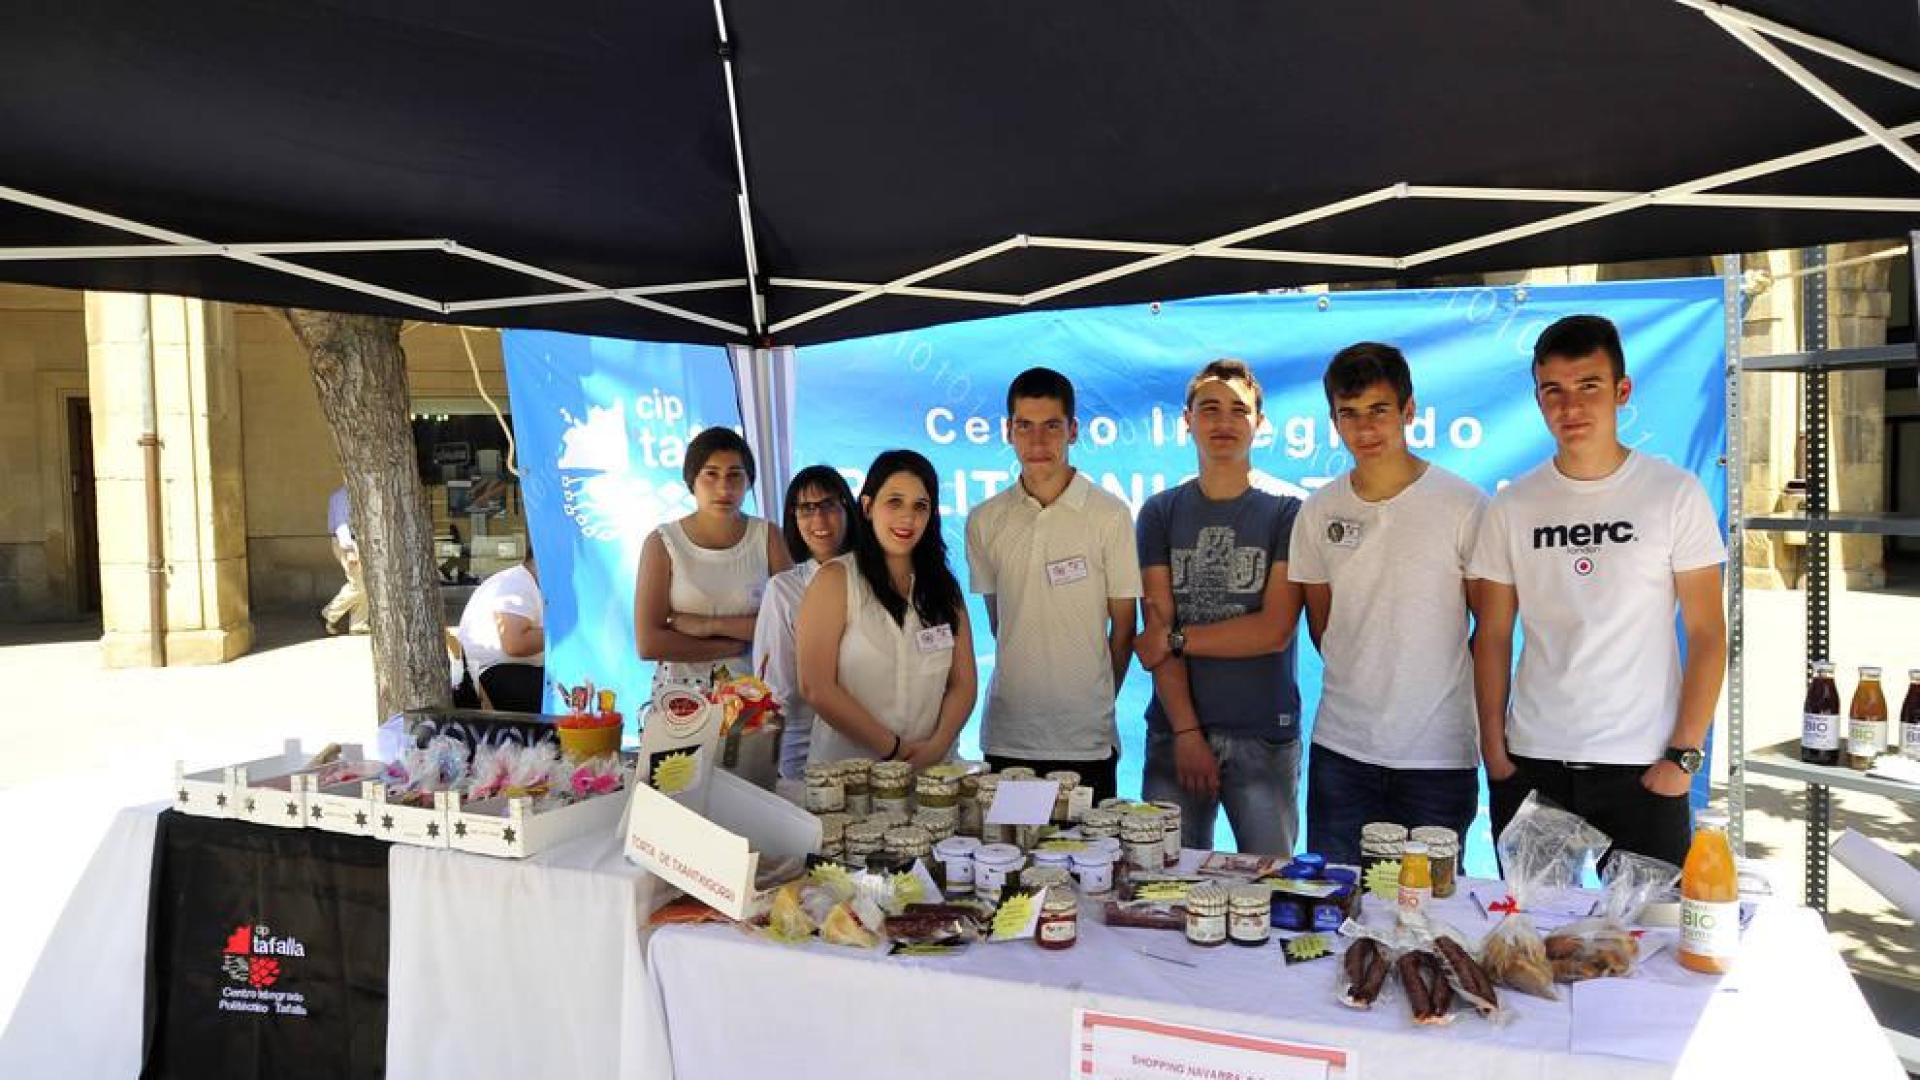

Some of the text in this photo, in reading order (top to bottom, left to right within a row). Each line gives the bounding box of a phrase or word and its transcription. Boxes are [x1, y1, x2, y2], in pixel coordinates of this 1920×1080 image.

[635, 387, 684, 425] cip
[926, 405, 1484, 459] Ceo Iegdo
[1532, 520, 1639, 550] merc.
[1681, 907, 1716, 930] BIO
[253, 935, 306, 958] tafalla
[222, 986, 257, 999] Centro
[1131, 1054, 1185, 1074] SHOPPING
